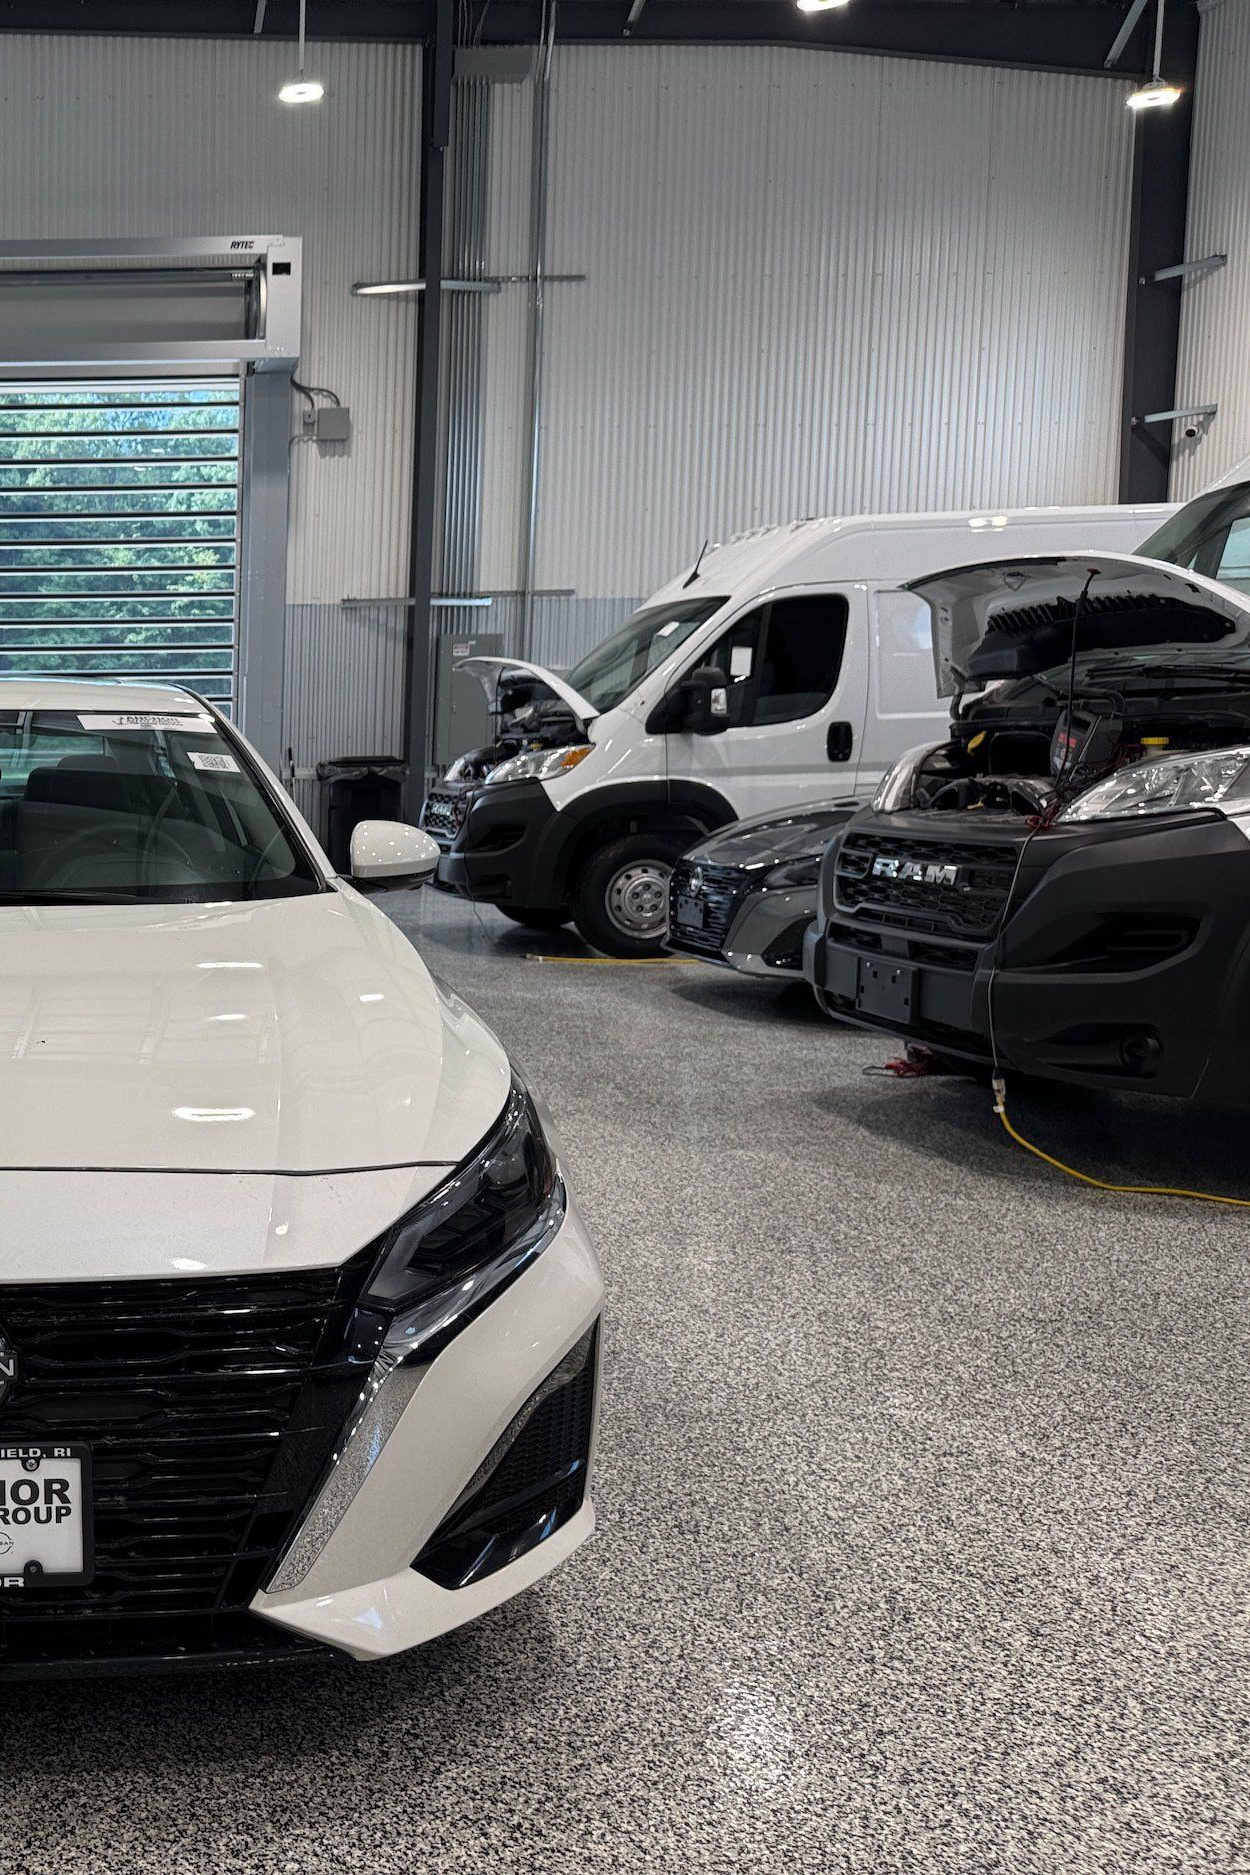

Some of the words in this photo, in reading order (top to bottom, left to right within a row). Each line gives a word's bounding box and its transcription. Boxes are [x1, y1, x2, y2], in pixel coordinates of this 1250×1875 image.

[230, 240, 254, 249] RYTEC
[872, 857, 958, 885] RAM
[54, 1447, 71, 1457] RI
